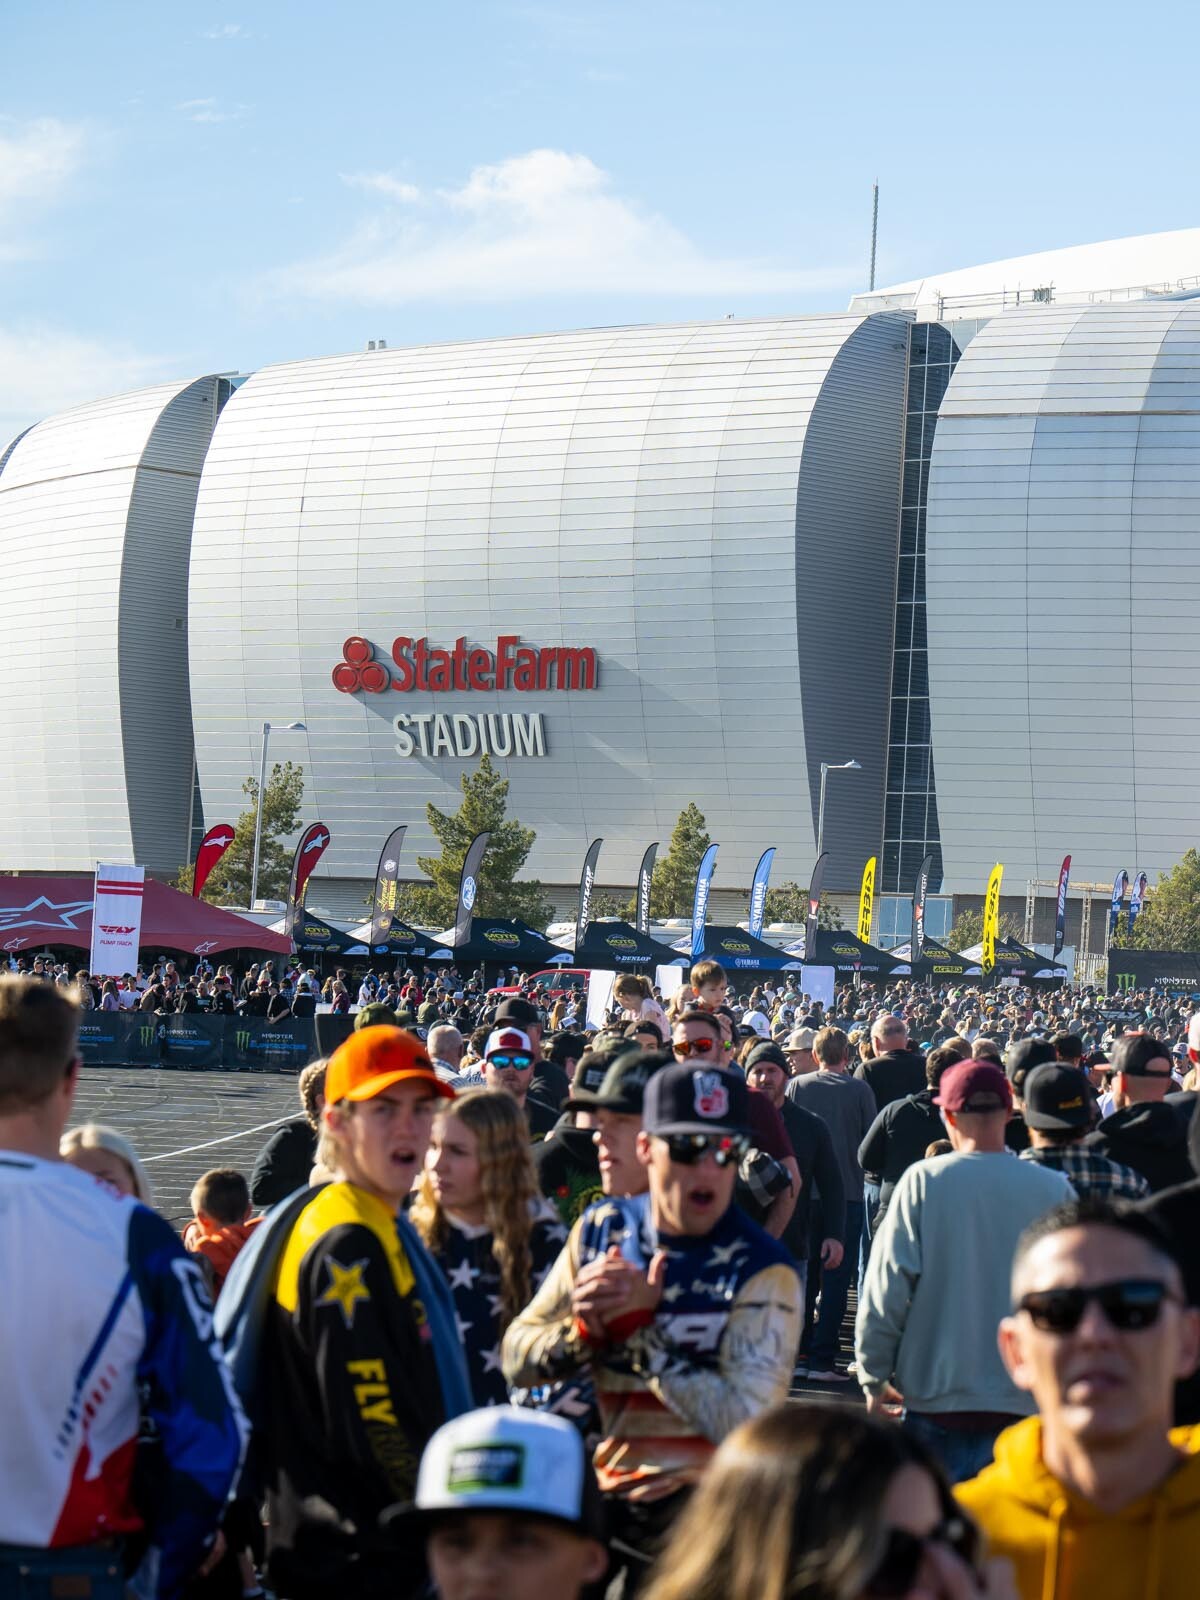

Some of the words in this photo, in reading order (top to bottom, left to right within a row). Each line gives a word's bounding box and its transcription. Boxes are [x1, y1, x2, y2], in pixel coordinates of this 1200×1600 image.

[392, 713, 549, 757] STADIUM
[580, 865, 593, 928] DUNLOP
[696, 878, 707, 918] YAMAHA
[753, 882, 765, 922] YAMAHA
[98, 925, 136, 933] FLY
[1154, 976, 1198, 986] MONSTER
[345, 1359, 398, 1427] FLY
